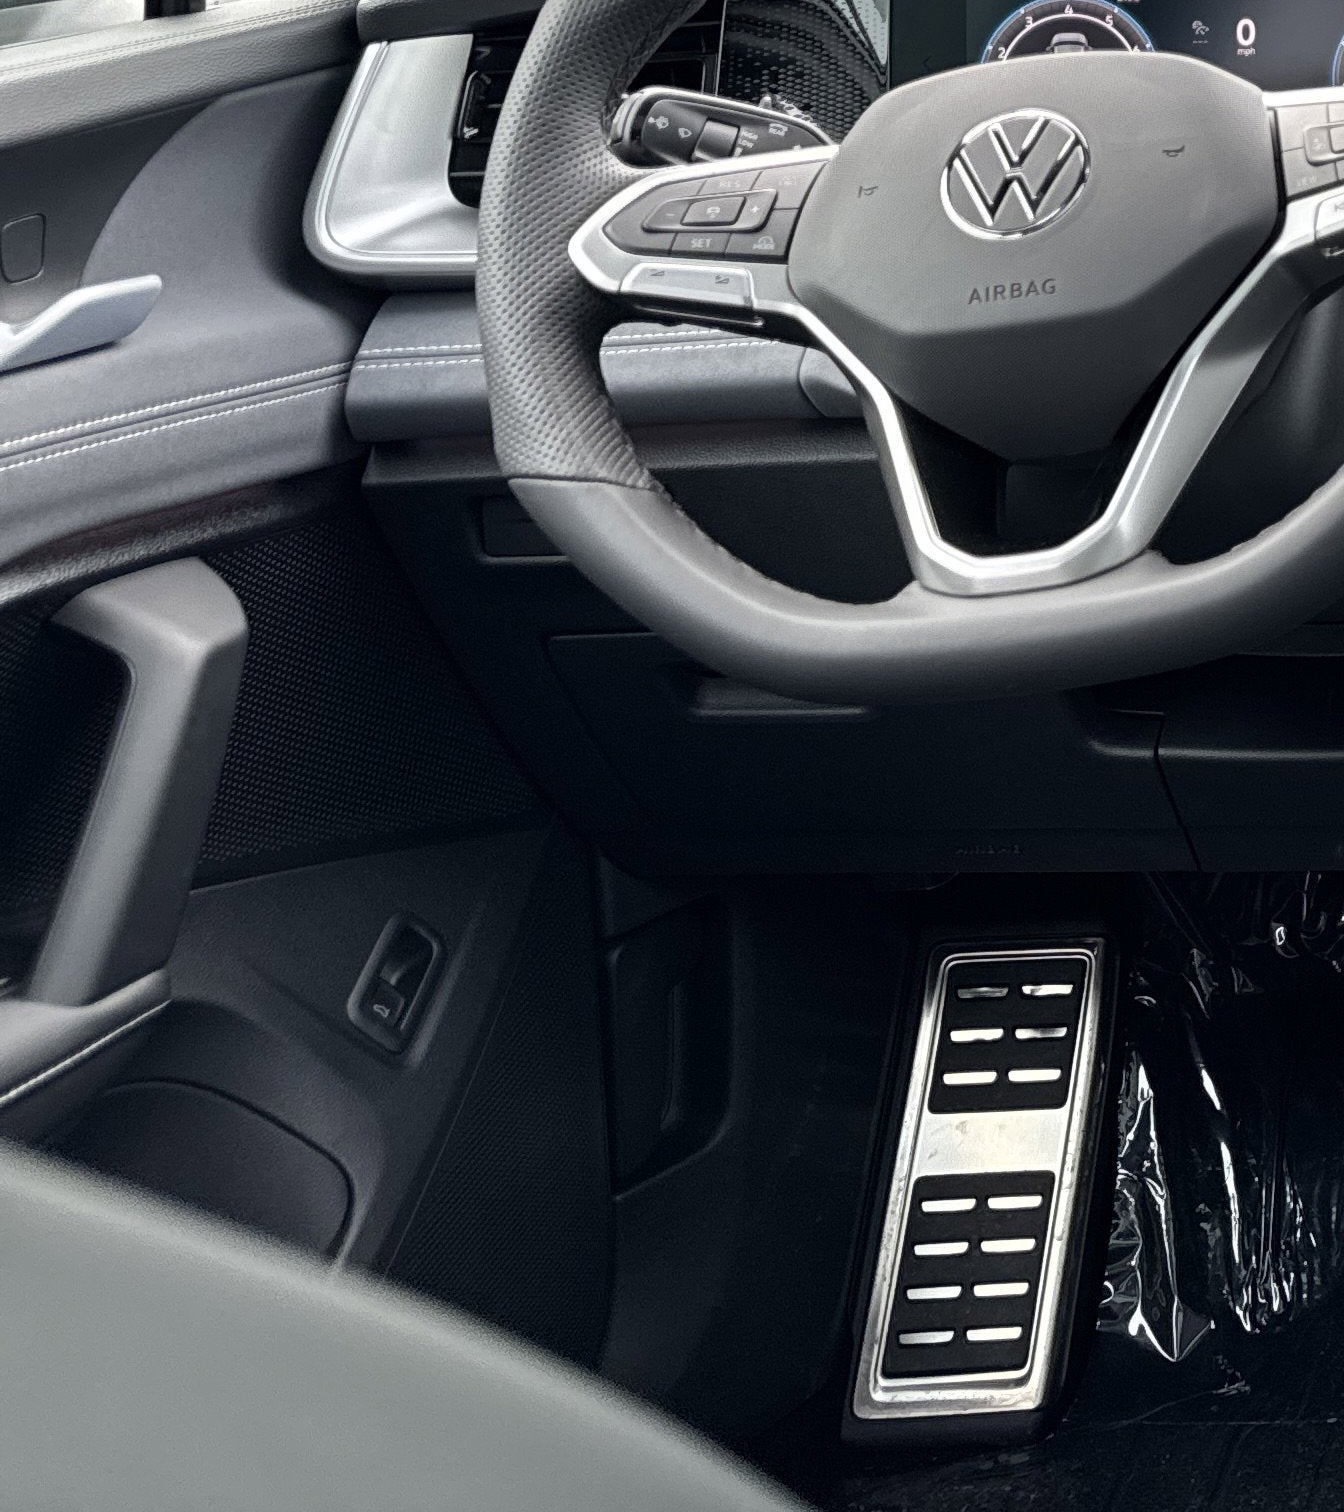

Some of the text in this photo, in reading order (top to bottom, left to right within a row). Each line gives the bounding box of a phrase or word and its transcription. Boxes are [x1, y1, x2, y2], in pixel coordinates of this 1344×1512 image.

[1063, 4, 1074, 16] 4
[1024, 16, 1034, 28] 3
[1104, 15, 1115, 28] 5
[1235, 17, 1257, 47] 0
[997, 46, 1007, 59] 2
[1236, 46, 1257, 58] mph
[690, 238, 713, 249] SET
[752, 241, 776, 251] MODE
[966, 277, 1058, 306] AIRBAG
